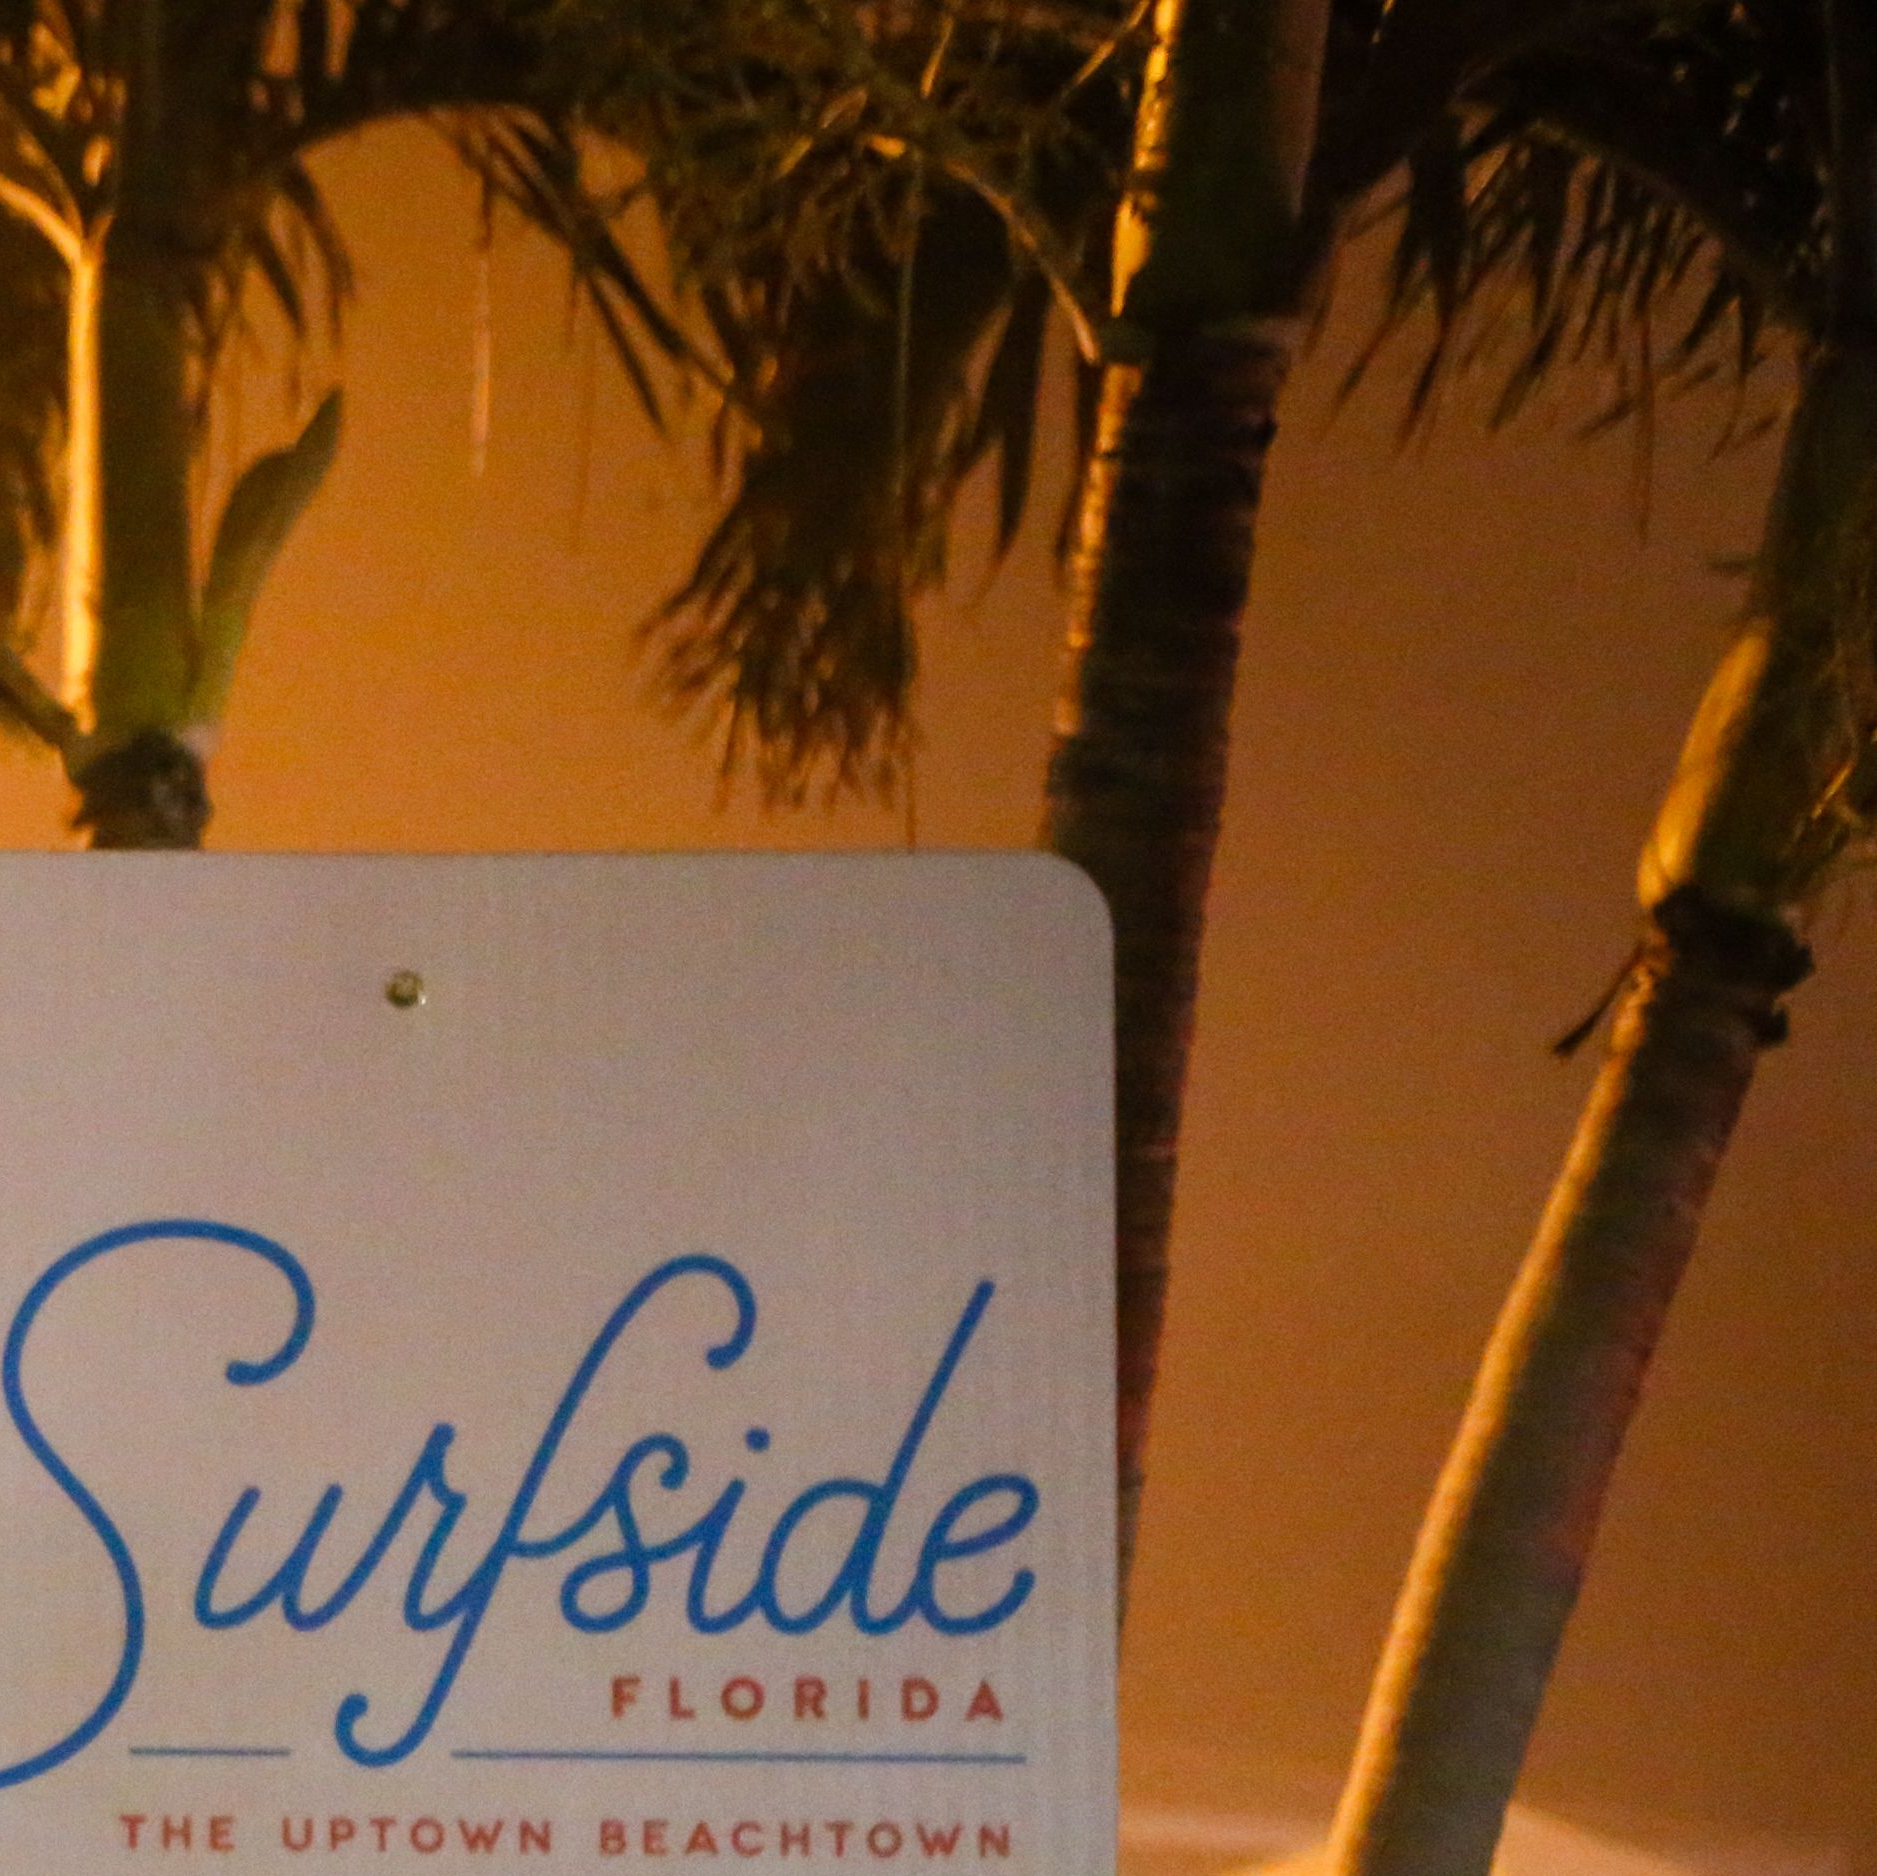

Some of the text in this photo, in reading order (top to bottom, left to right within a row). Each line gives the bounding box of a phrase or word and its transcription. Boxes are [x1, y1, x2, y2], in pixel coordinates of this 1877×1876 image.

[608, 1673, 1004, 1724] FLORIDA
[118, 1812, 1012, 1858] THE UPTOWN BEACHTOWN
